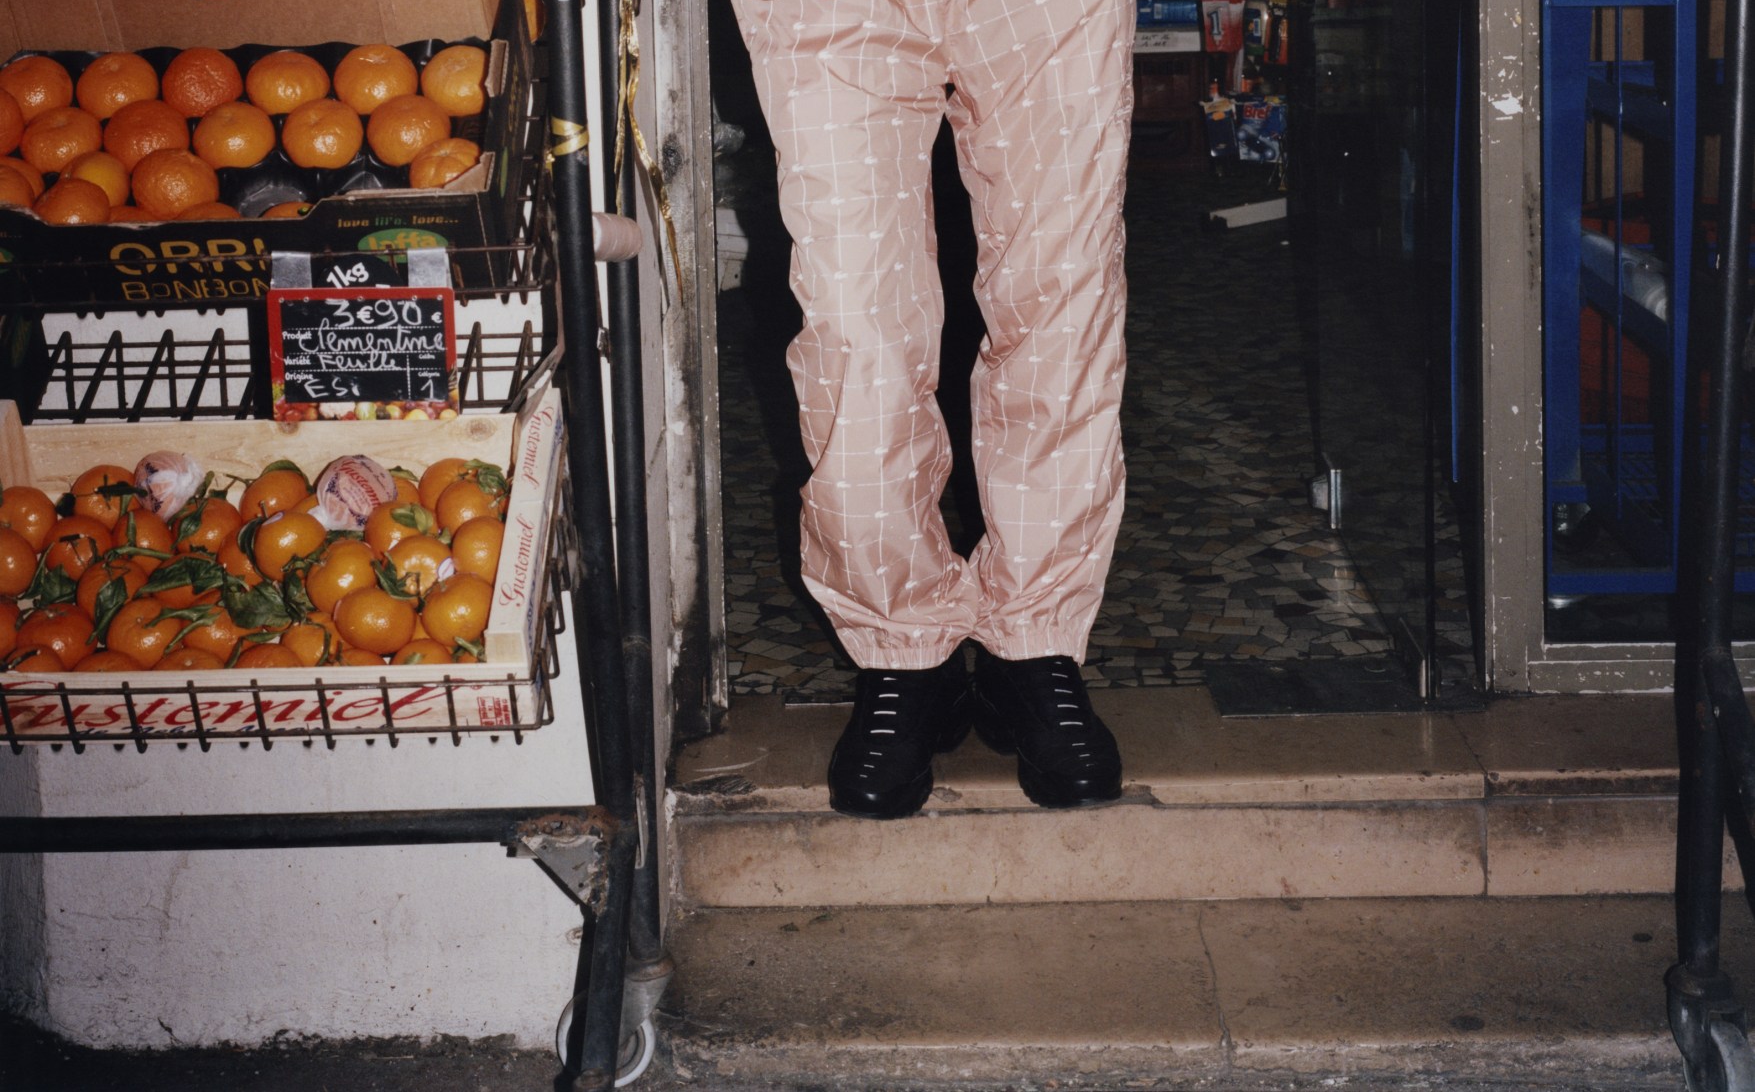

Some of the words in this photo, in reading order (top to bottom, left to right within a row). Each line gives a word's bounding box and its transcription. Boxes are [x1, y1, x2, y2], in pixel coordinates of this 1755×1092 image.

[1244, 102, 1272, 120] Bref
[337, 218, 369, 228] love
[110, 237, 266, 276] ORRI
[326, 262, 370, 289] 1kg
[431, 312, 442, 324] €
[282, 330, 312, 340] Produit
[284, 354, 311, 365] Variété
[285, 371, 314, 383] Origine
[499, 513, 534, 608] Gustemiel
